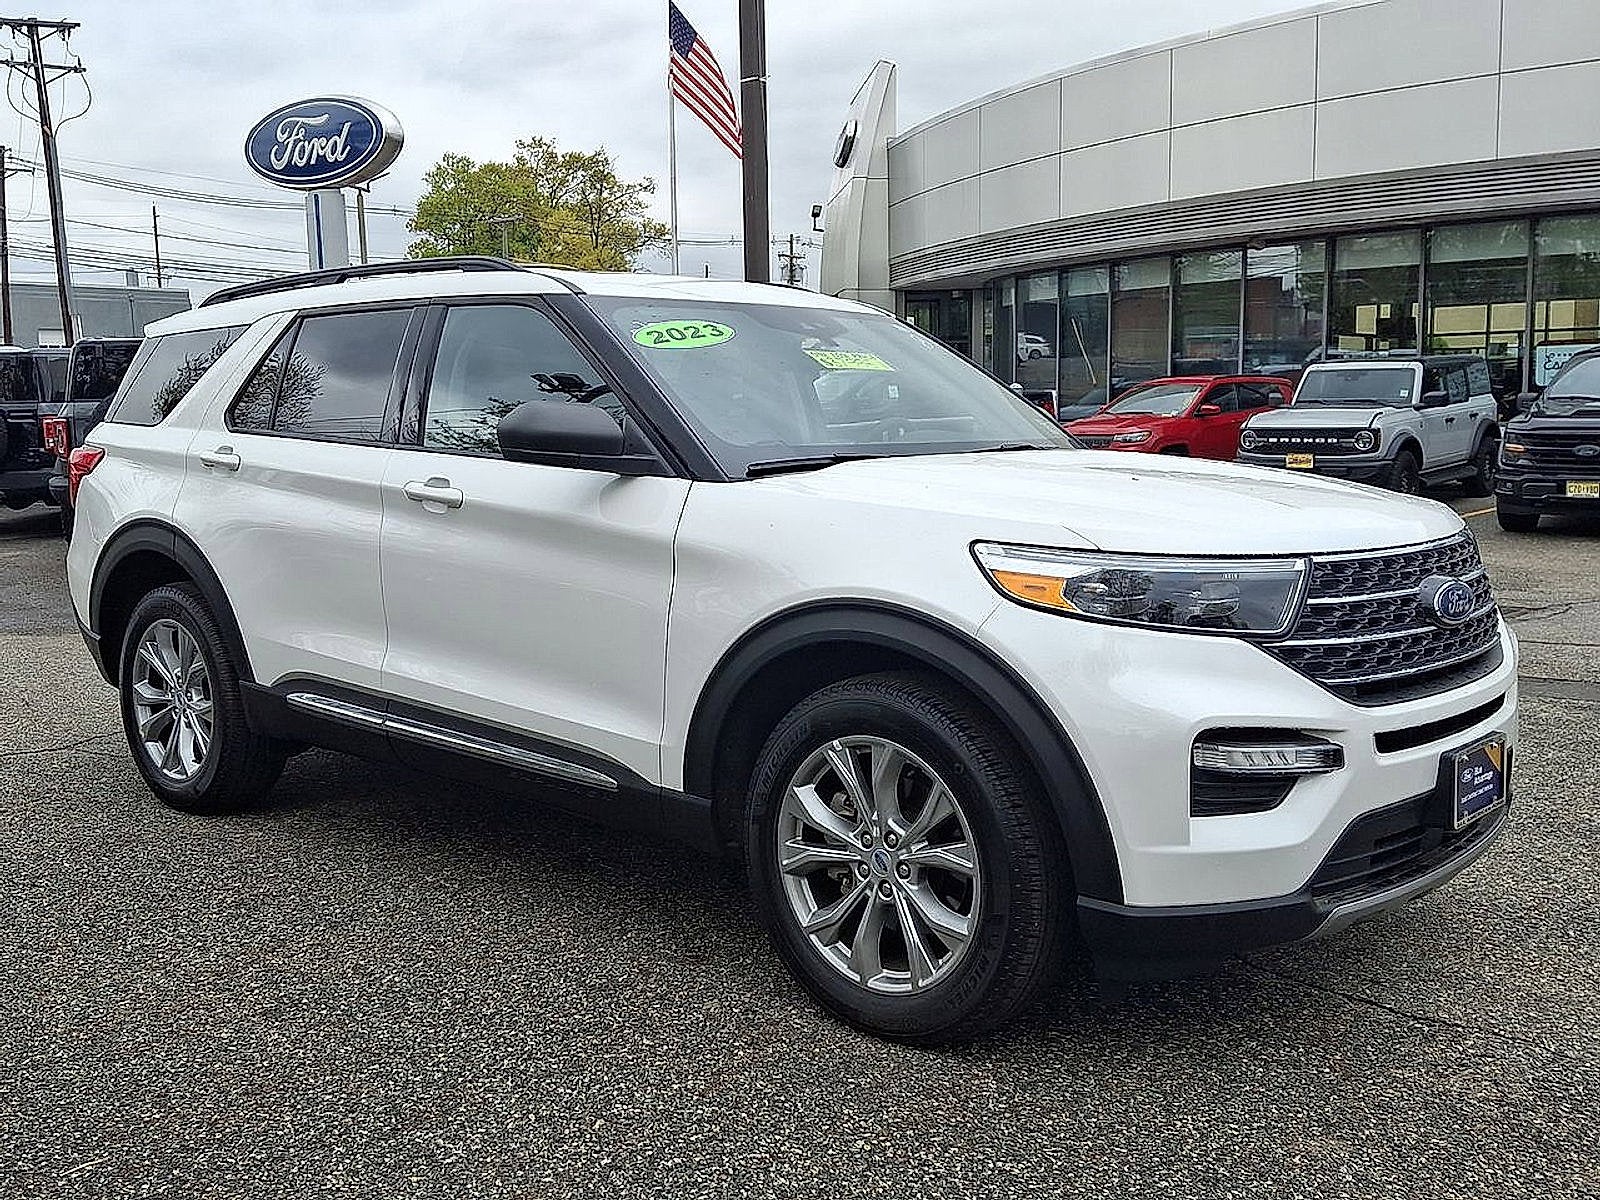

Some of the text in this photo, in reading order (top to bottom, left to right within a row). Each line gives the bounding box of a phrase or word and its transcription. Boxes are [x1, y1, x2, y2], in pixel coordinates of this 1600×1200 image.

[270, 113, 351, 170] Ford
[646, 324, 724, 344] 2023
[1448, 589, 1470, 613] Ford
